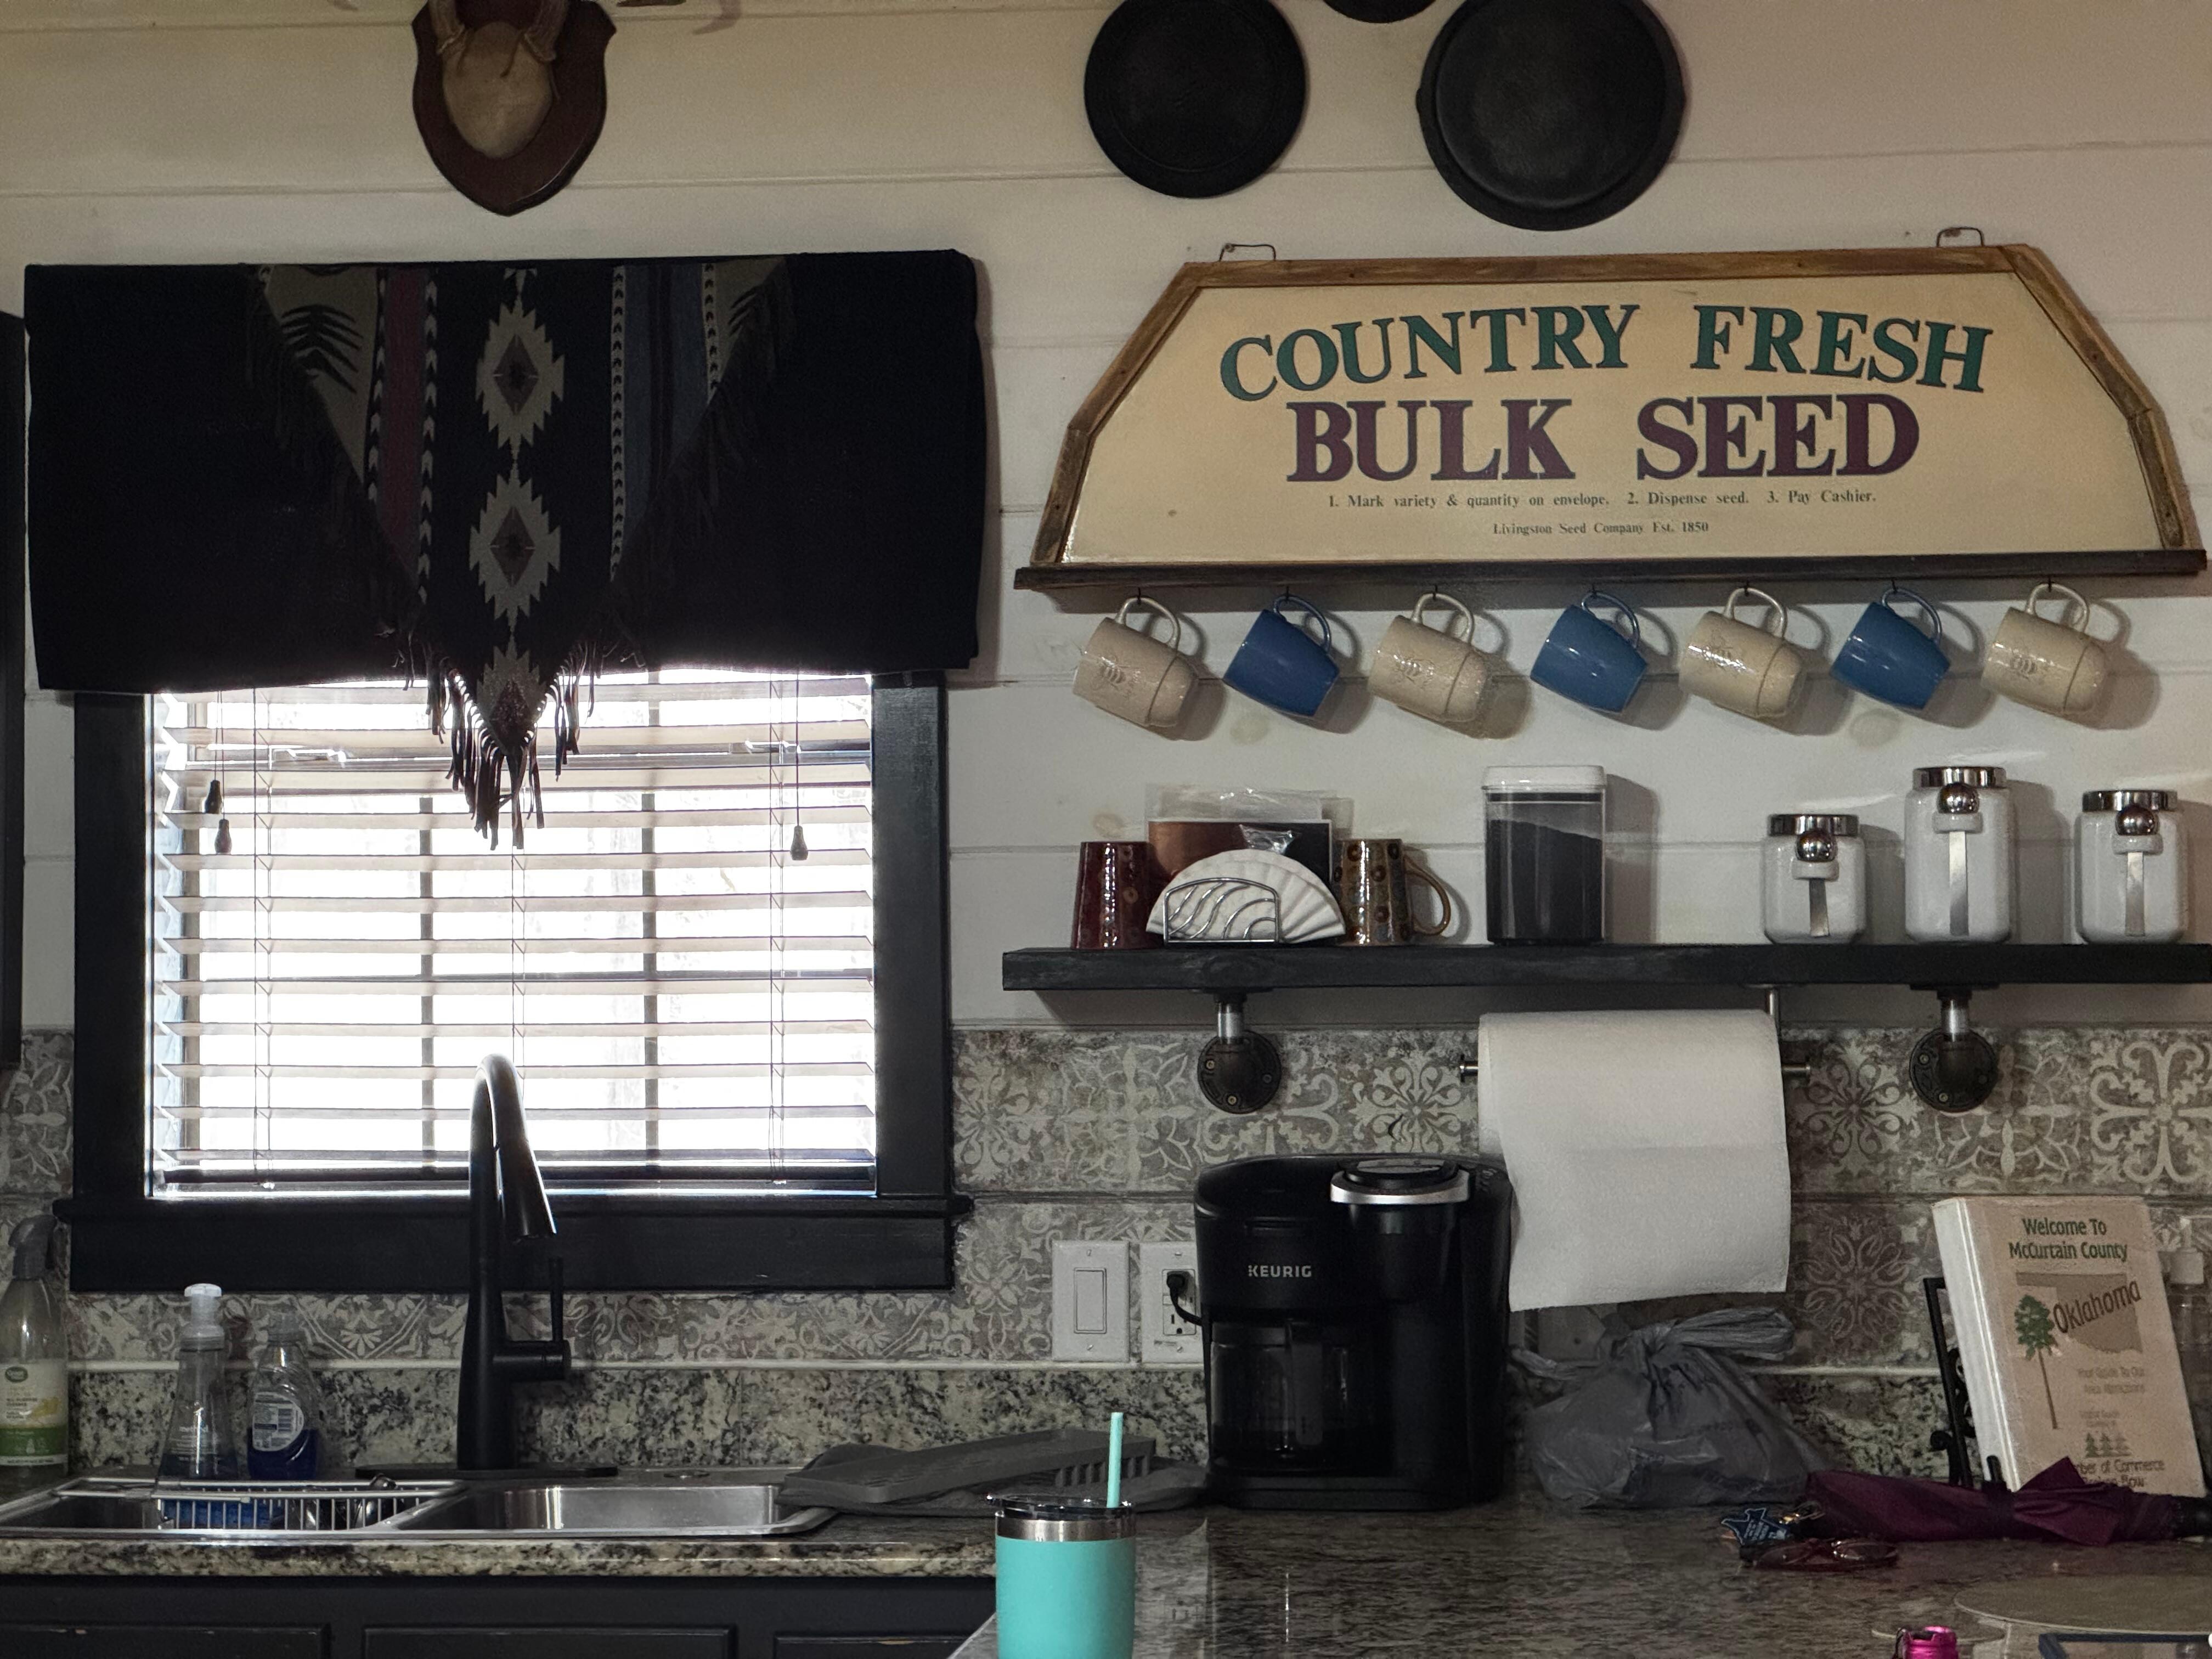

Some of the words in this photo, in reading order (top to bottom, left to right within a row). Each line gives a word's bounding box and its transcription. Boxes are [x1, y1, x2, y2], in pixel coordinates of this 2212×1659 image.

[1220, 304, 1641, 402] COUNTRY
[1690, 304, 1994, 393] FRESH
[1285, 398, 1576, 482] BULK
[1637, 393, 1920, 481] SEED
[1329, 495, 1339, 507] 1.
[1347, 495, 1384, 507] Mark
[1394, 495, 1436, 508] variety
[1446, 494, 1458, 506] &
[1467, 494, 1519, 508] quantity
[1529, 496, 1544, 506] on
[1553, 493, 1610, 508] envelope.
[1627, 492, 1639, 504] 2.
[1648, 492, 1707, 506] Dispense
[1716, 492, 1749, 504] seed.
[1767, 490, 1780, 503] 3.
[1788, 490, 1810, 505] Pay
[1820, 490, 1877, 503] Cashier.
[1493, 523, 1553, 535] Livingston
[1559, 523, 1587, 534] Seed
[1594, 522, 1644, 535] Company
[1652, 522, 1675, 533] Est.
[1681, 521, 1709, 533] 1850
[2021, 1217, 2087, 1235] Welcome
[2089, 1218, 2107, 1235] To
[2008, 1240, 2078, 1259] McCurtain
[2080, 1242, 2128, 1262] County
[1248, 1265, 1312, 1278] KEURIG
[2053, 1280, 2142, 1334] Oklahoma
[2101, 1459, 2111, 1474] of
[2114, 1459, 2165, 1472] Commerce
